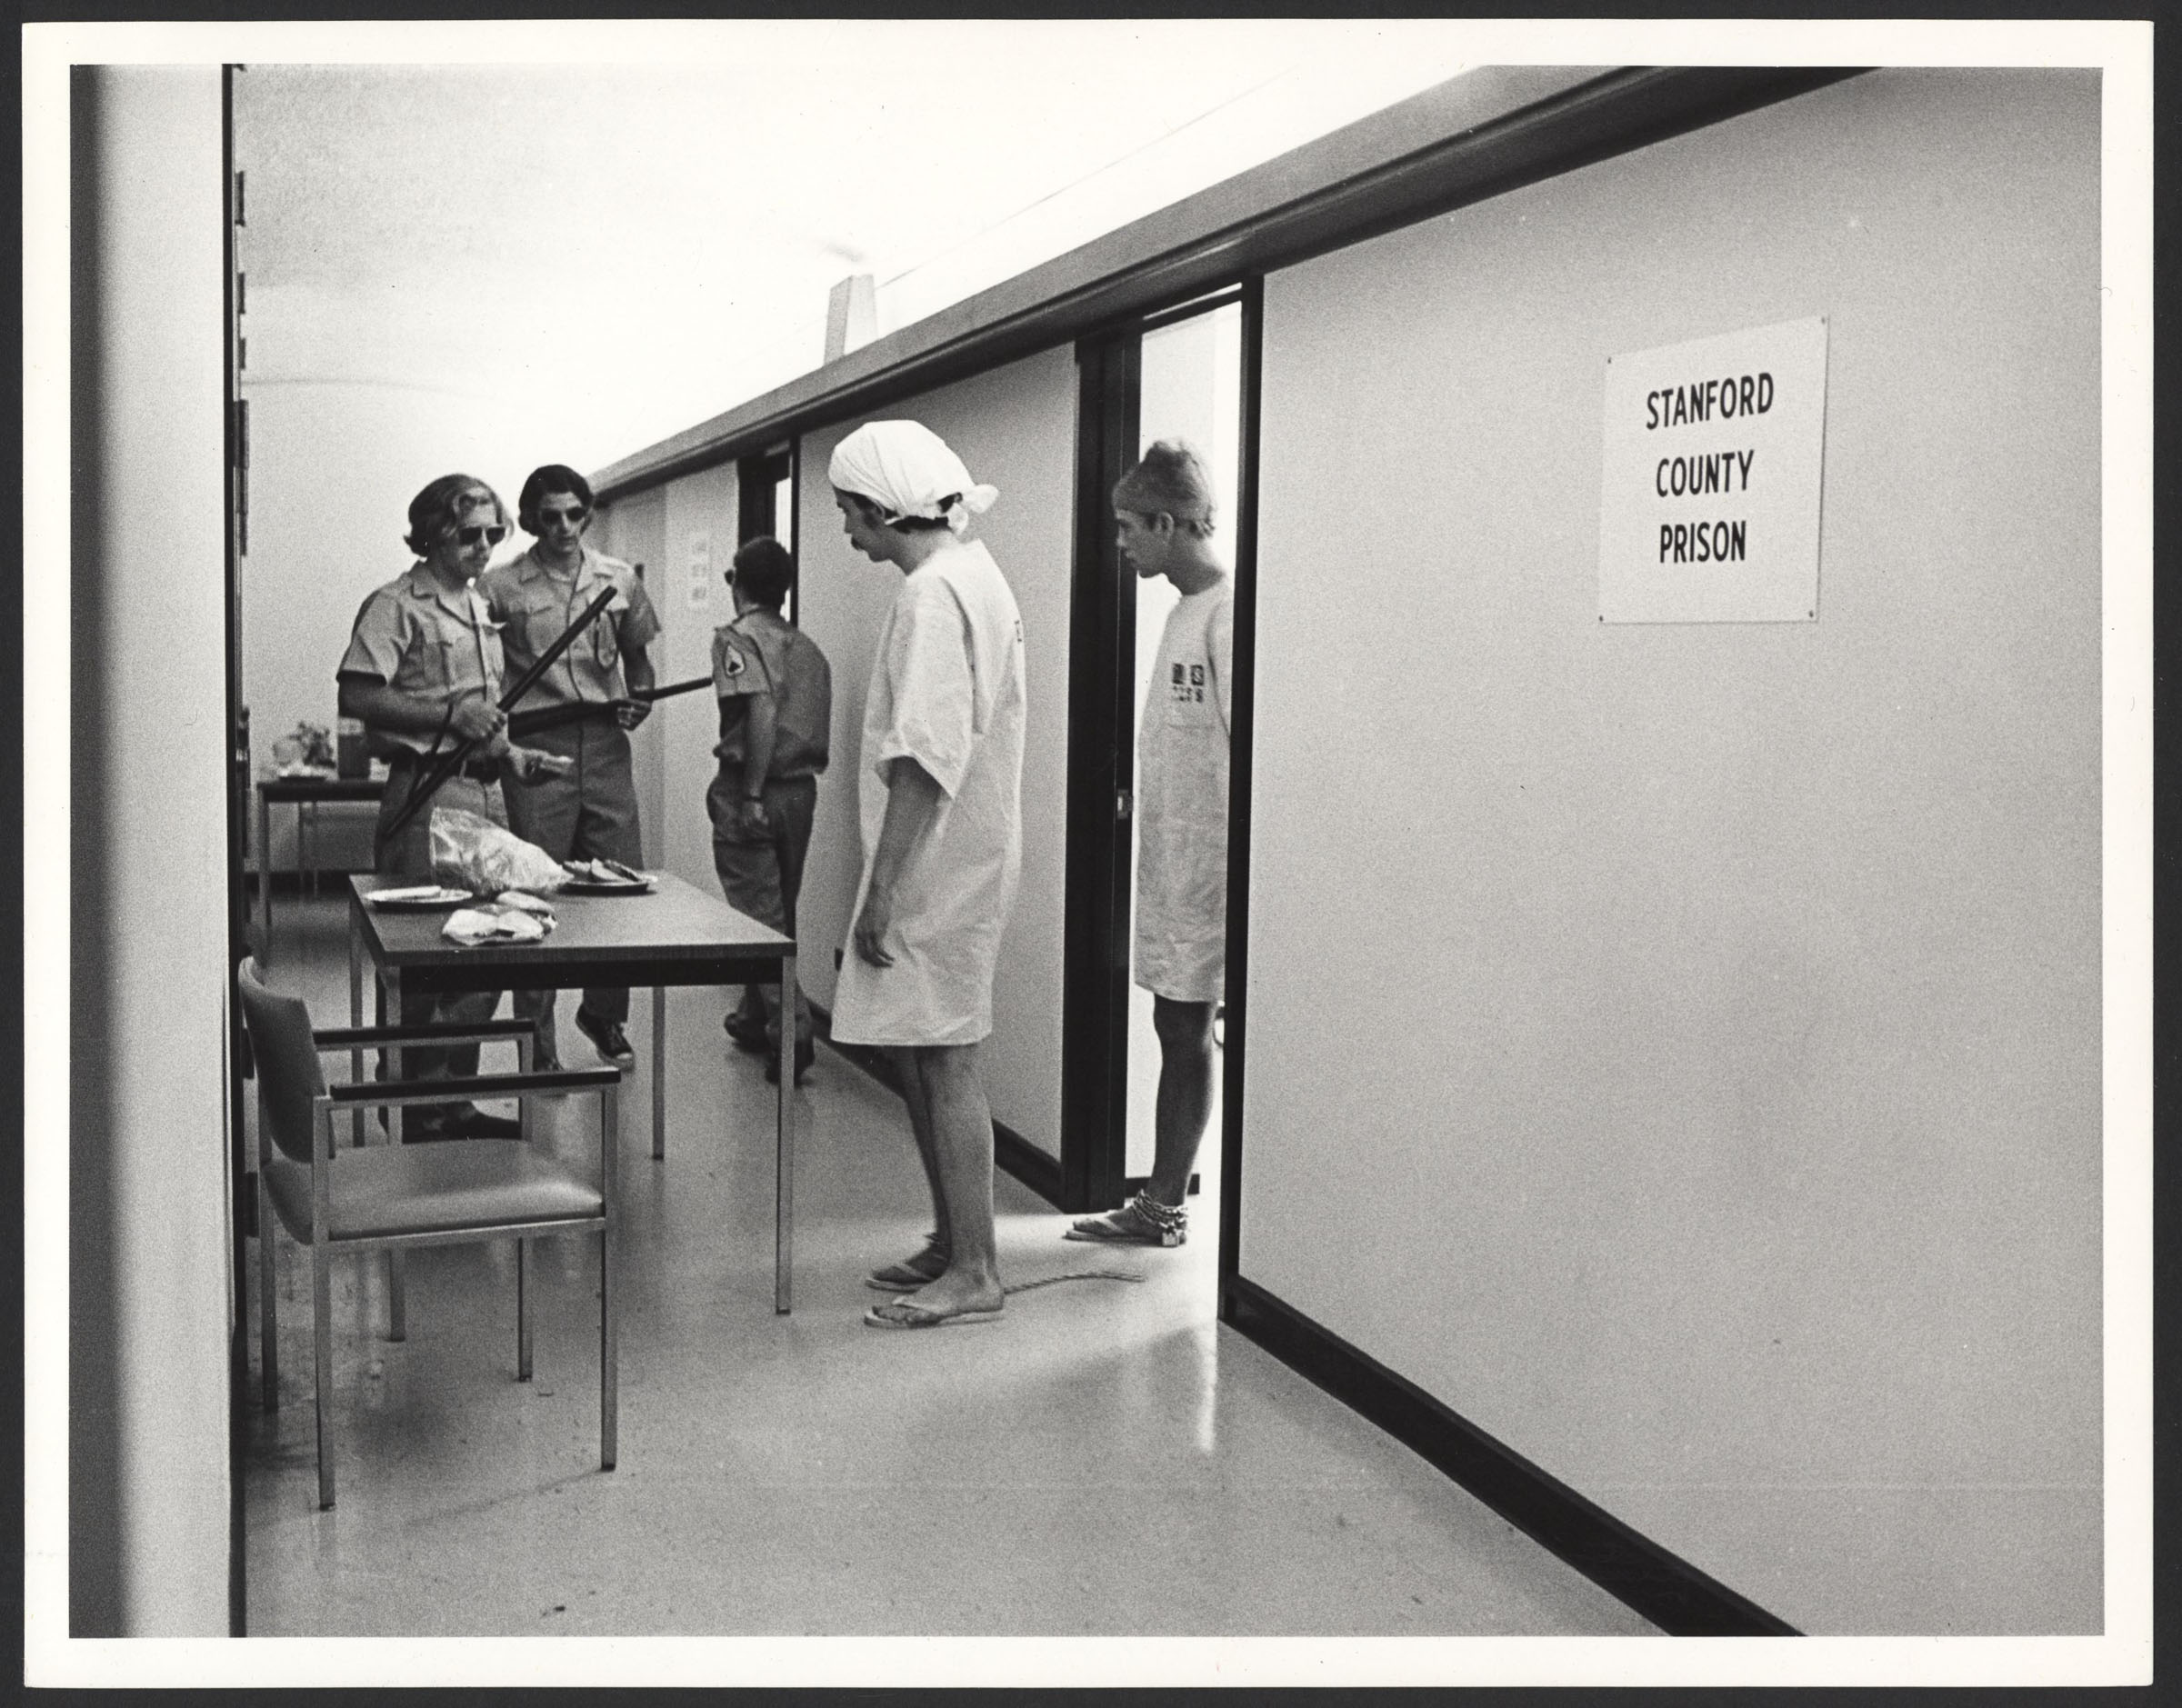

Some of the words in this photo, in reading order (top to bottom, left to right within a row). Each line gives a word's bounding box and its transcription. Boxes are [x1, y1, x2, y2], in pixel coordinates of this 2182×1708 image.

[1647, 373, 1774, 430] STANFORD
[1657, 449, 1755, 497] COUNTY
[1660, 520, 1747, 564] PRISON
